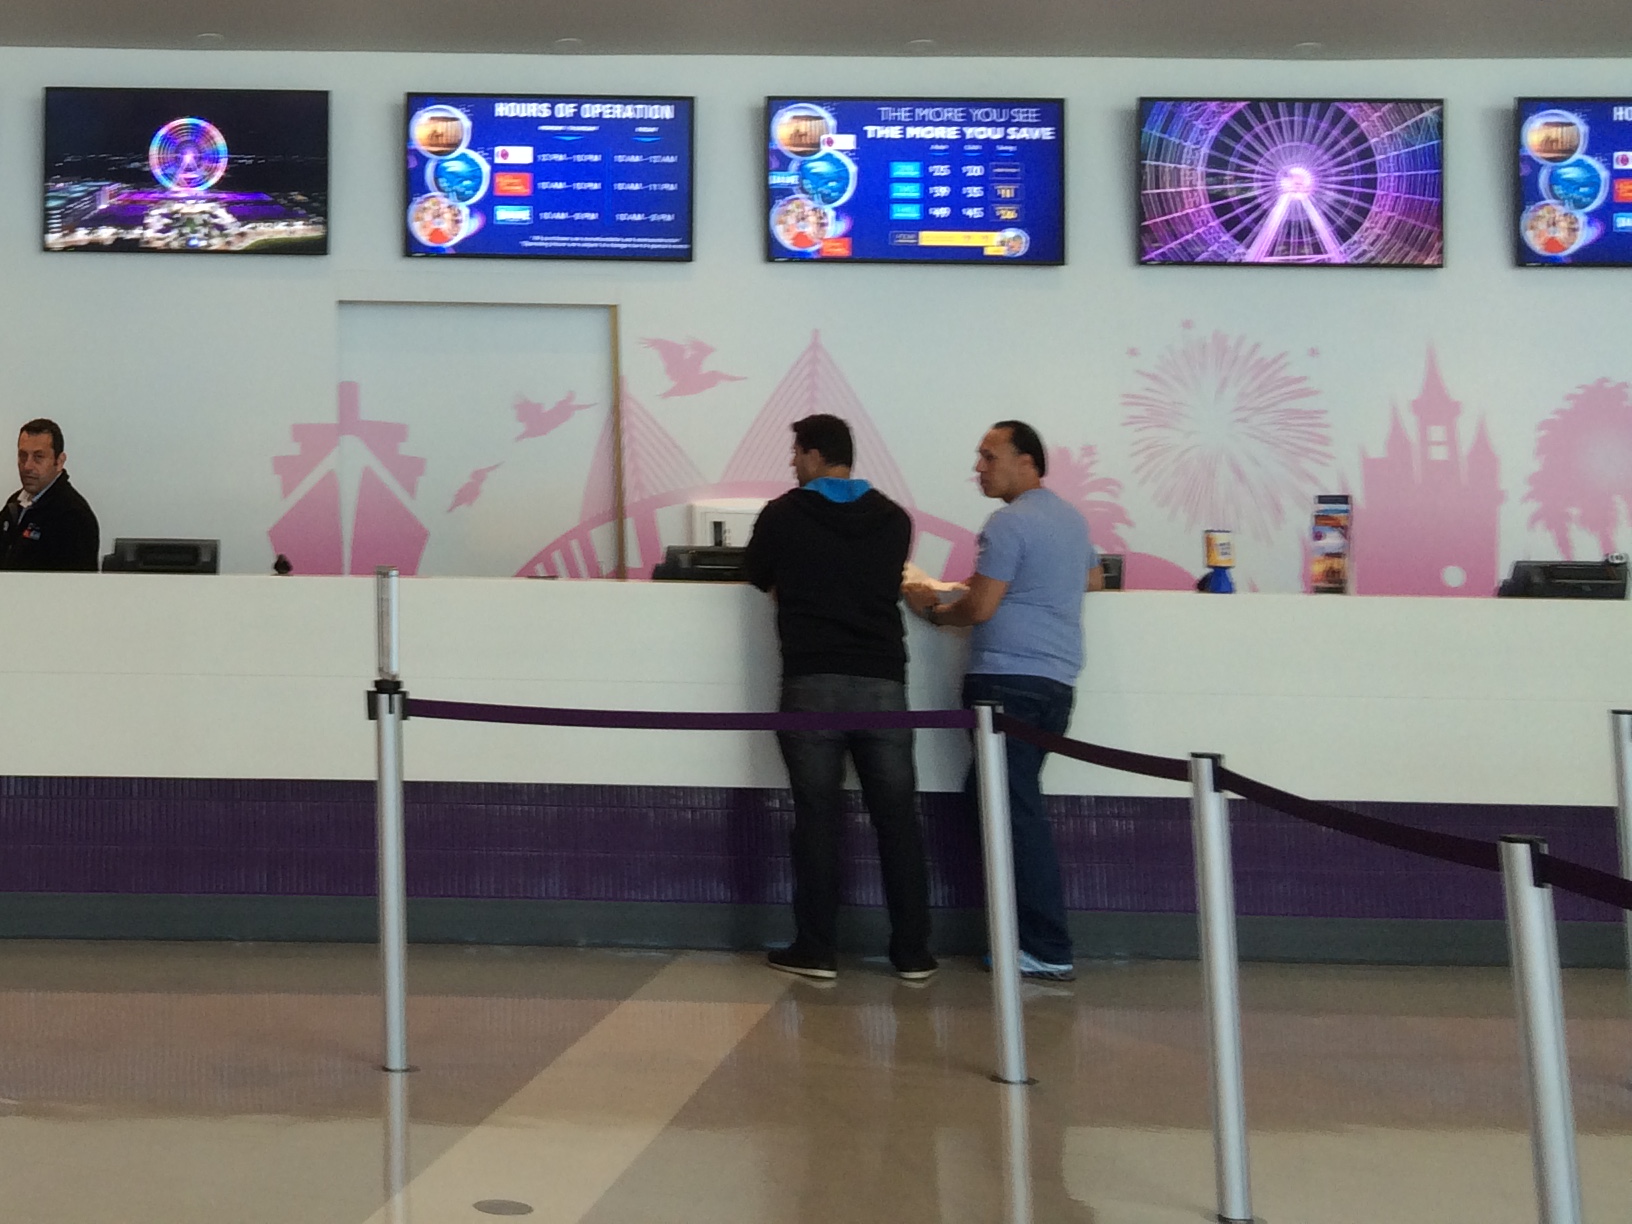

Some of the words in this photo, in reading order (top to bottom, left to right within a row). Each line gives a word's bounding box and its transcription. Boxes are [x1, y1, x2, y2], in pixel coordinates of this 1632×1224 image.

[494, 102, 551, 117] HOURS
[555, 103, 578, 119] OF
[580, 104, 675, 119] OPERATION
[877, 107, 913, 122] THE
[915, 107, 967, 122] MORE
[969, 107, 1010, 122] YOU
[1010, 108, 1042, 123] SEE
[863, 125, 904, 139] THE
[905, 126, 961, 139] MORE
[962, 126, 1005, 139] YOU
[1006, 127, 1056, 140] SAVE
